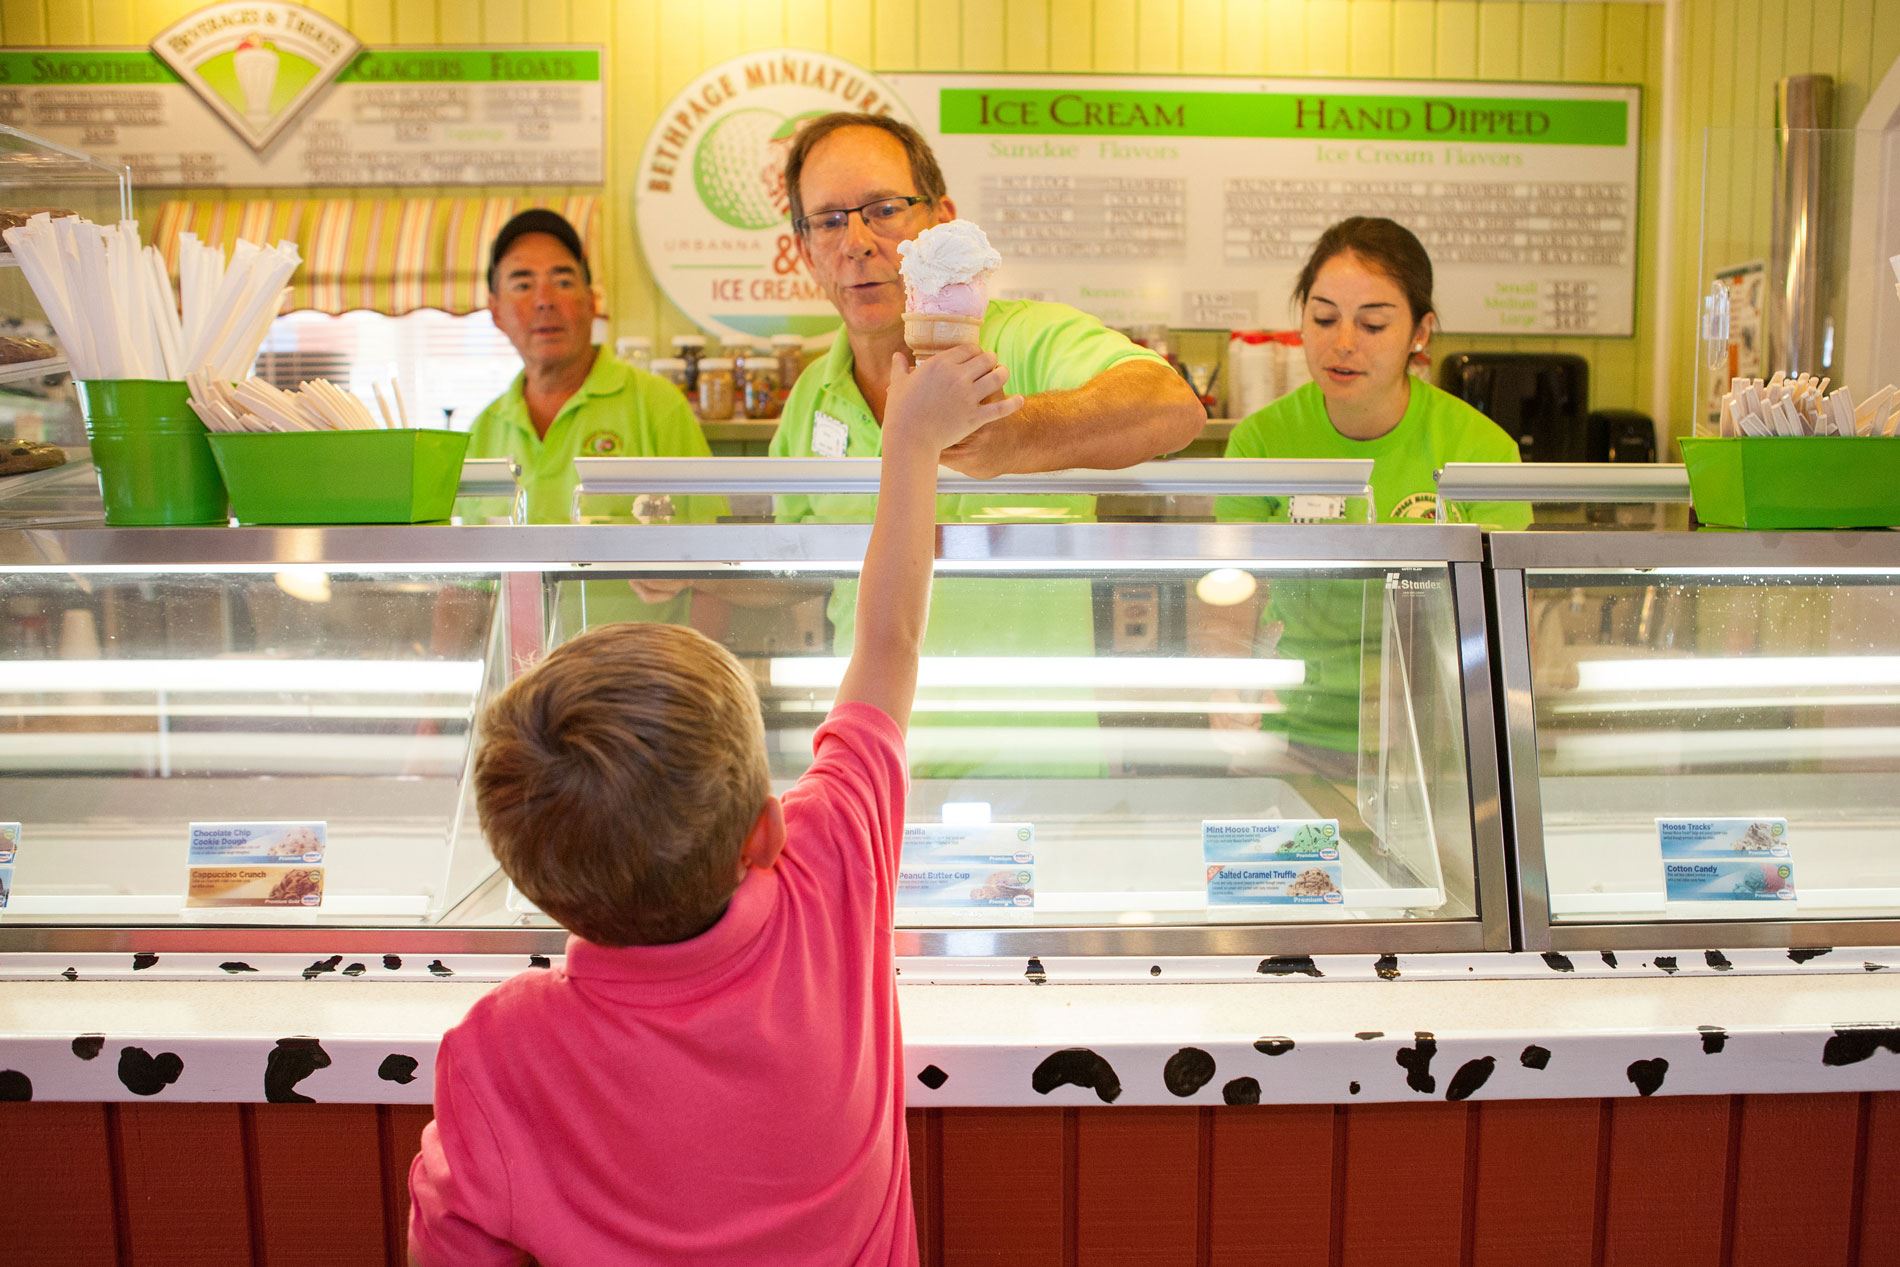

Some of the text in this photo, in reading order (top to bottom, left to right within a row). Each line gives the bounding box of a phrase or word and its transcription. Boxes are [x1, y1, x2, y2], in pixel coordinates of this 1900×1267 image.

[490, 53, 577, 80] FLOATS
[979, 93, 1186, 129] ICE CREAM
[1296, 98, 1551, 138] HAND DIPPED
[648, 56, 894, 193] BETHPAGE MINIATURE
[987, 140, 1181, 160] Sundae Flavors
[1315, 144, 1524, 167] Ice Cream Flavors
[773, 234, 801, 276] &
[711, 278, 745, 302] ICE
[1401, 579, 1441, 590] Standex
[905, 828, 926, 836] anilla
[1662, 823, 1686, 831] Moose
[193, 829, 252, 838] Chocolate Chip
[193, 838, 247, 846] Cookie Dough
[192, 871, 237, 879] Cappuccino
[1219, 870, 1297, 879] Salted Caramel Truffle
[1667, 865, 1718, 874] Cotton Candy
[954, 872, 970, 880] Cup
